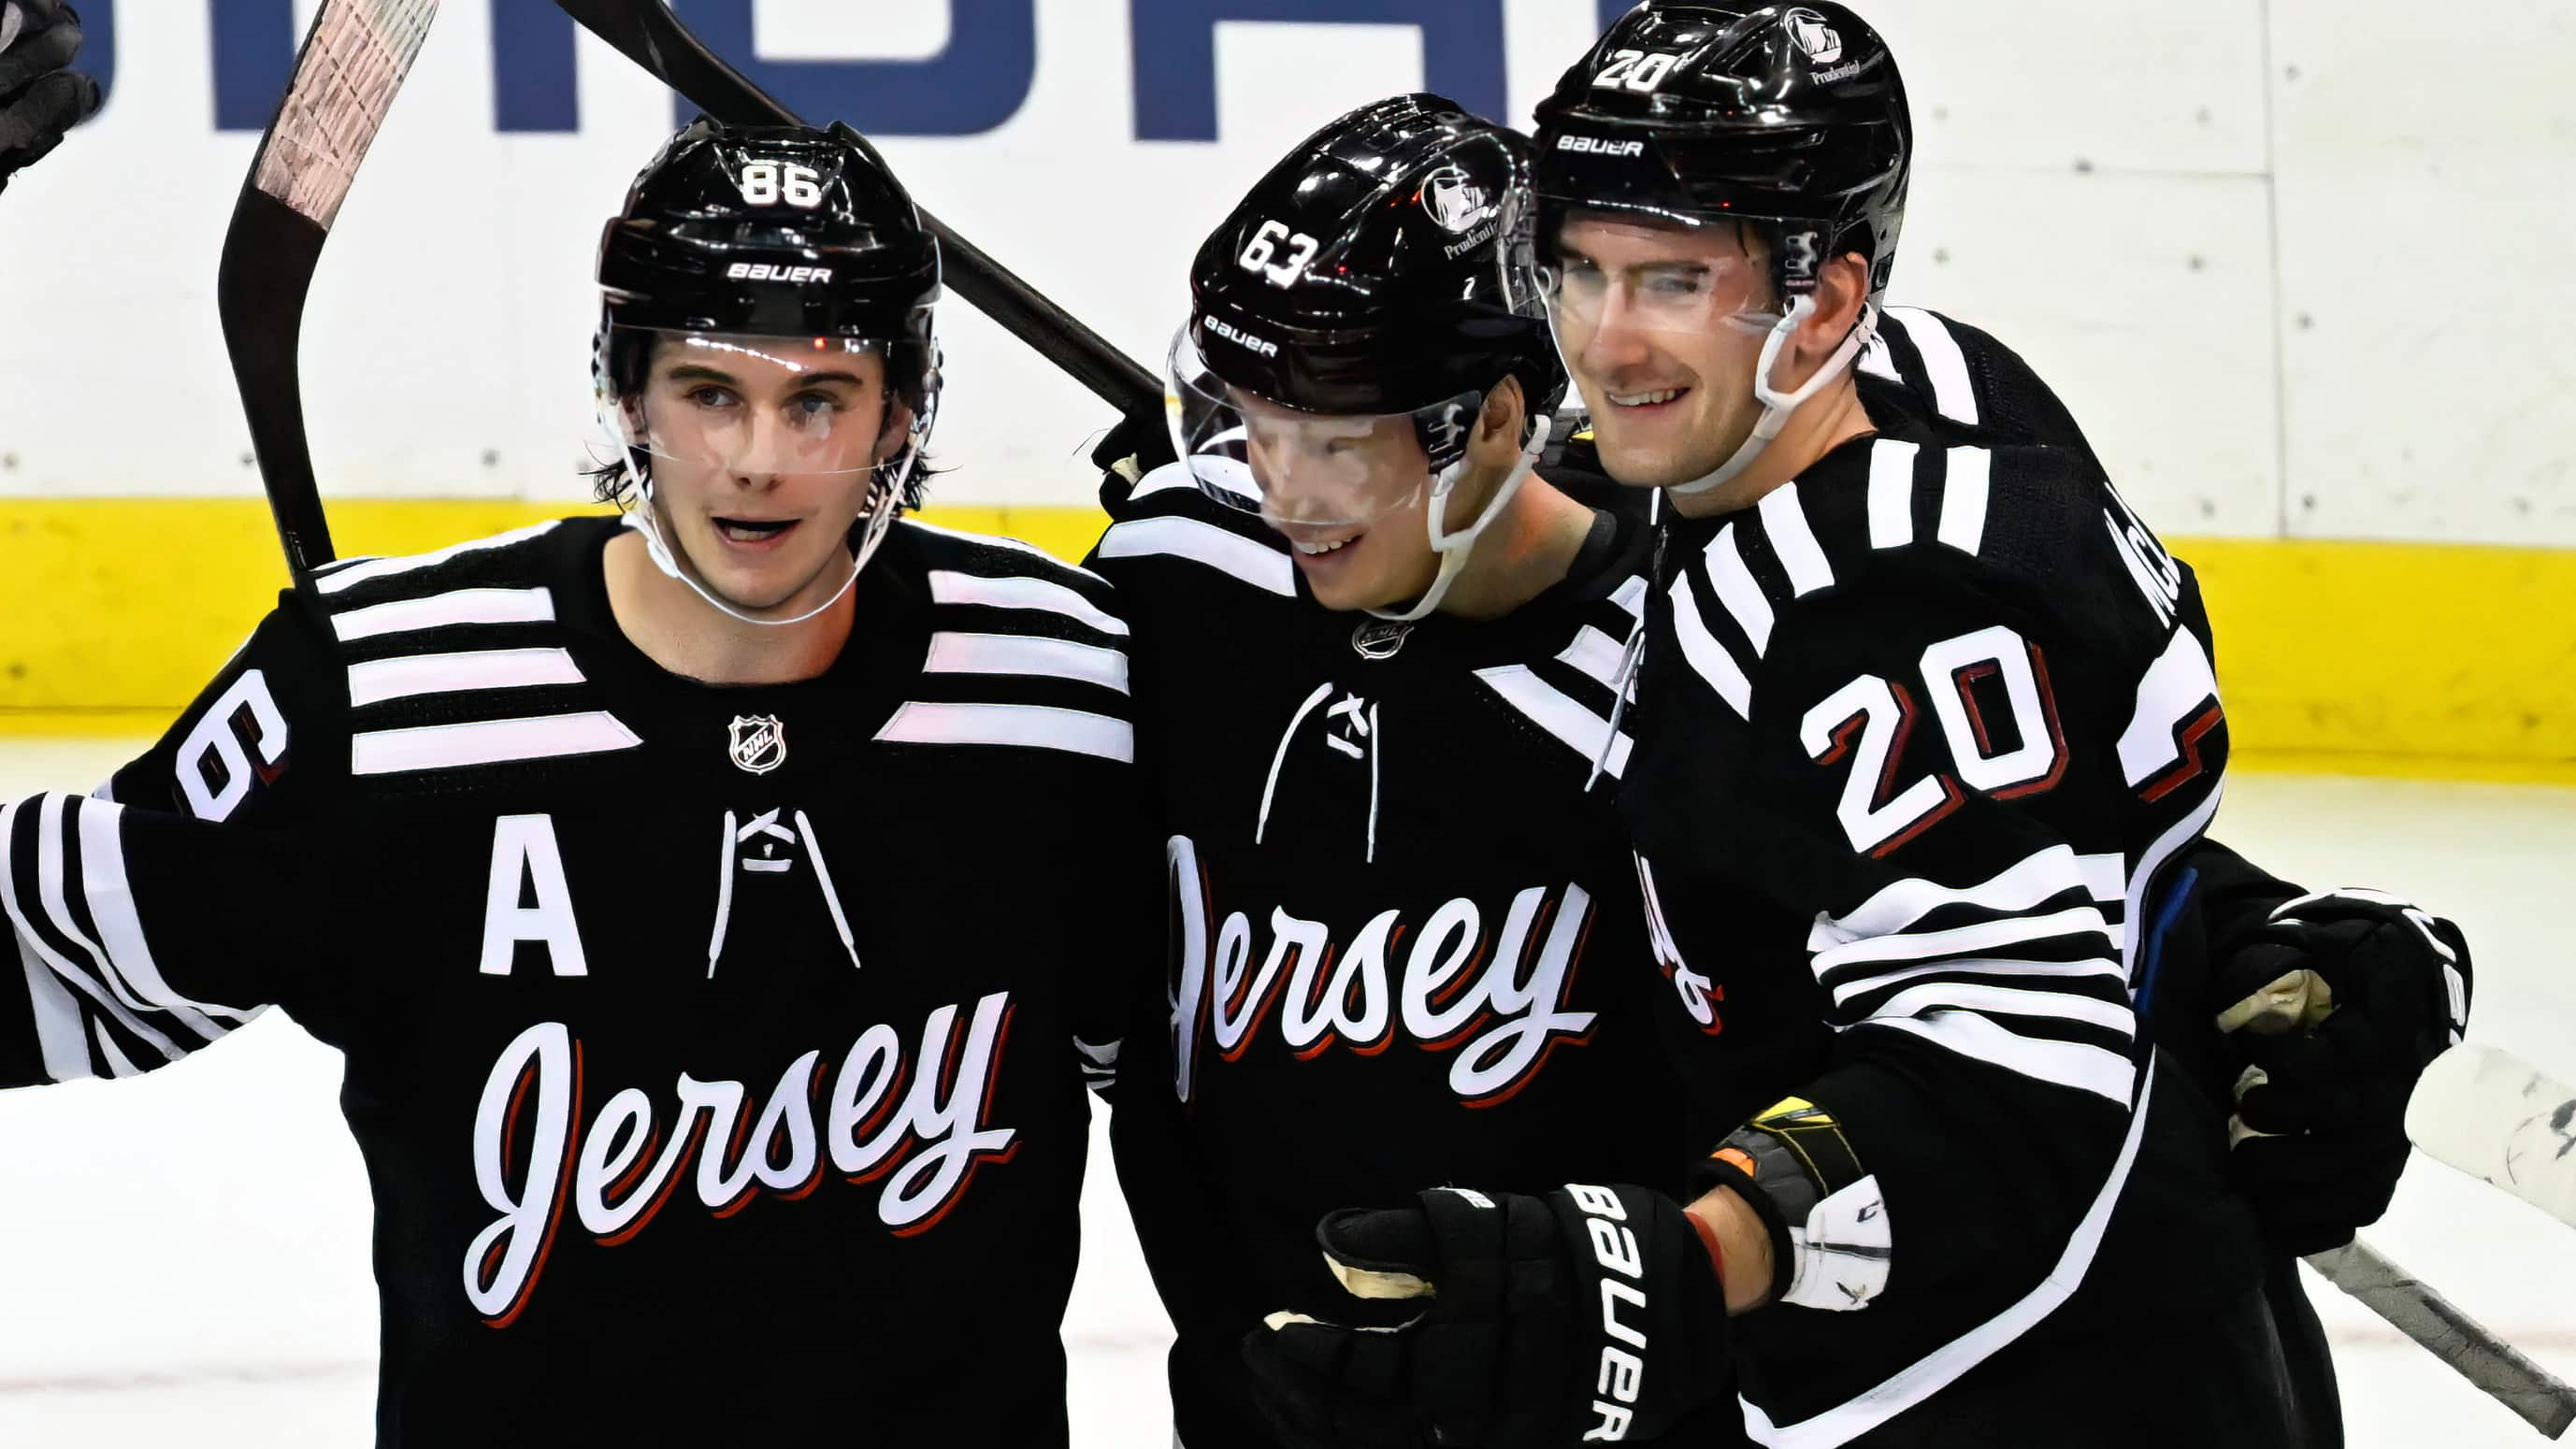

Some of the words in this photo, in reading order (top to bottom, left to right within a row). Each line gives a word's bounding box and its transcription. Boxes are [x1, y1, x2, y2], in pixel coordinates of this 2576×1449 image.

[1592, 50, 1677, 92] 20
[1557, 135, 1644, 157] BAUER
[741, 164, 822, 208] 86
[727, 263, 832, 284] BAUER
[1238, 220, 1317, 290] 63
[1204, 315, 1278, 358] BAUER
[741, 729, 775, 762] NHL
[1800, 625, 2068, 858] 20
[480, 813, 588, 976] A
[1167, 835, 1597, 1109] Jersey
[464, 991, 1022, 1329] Jersey
[1563, 1183, 1647, 1442] BAUER
